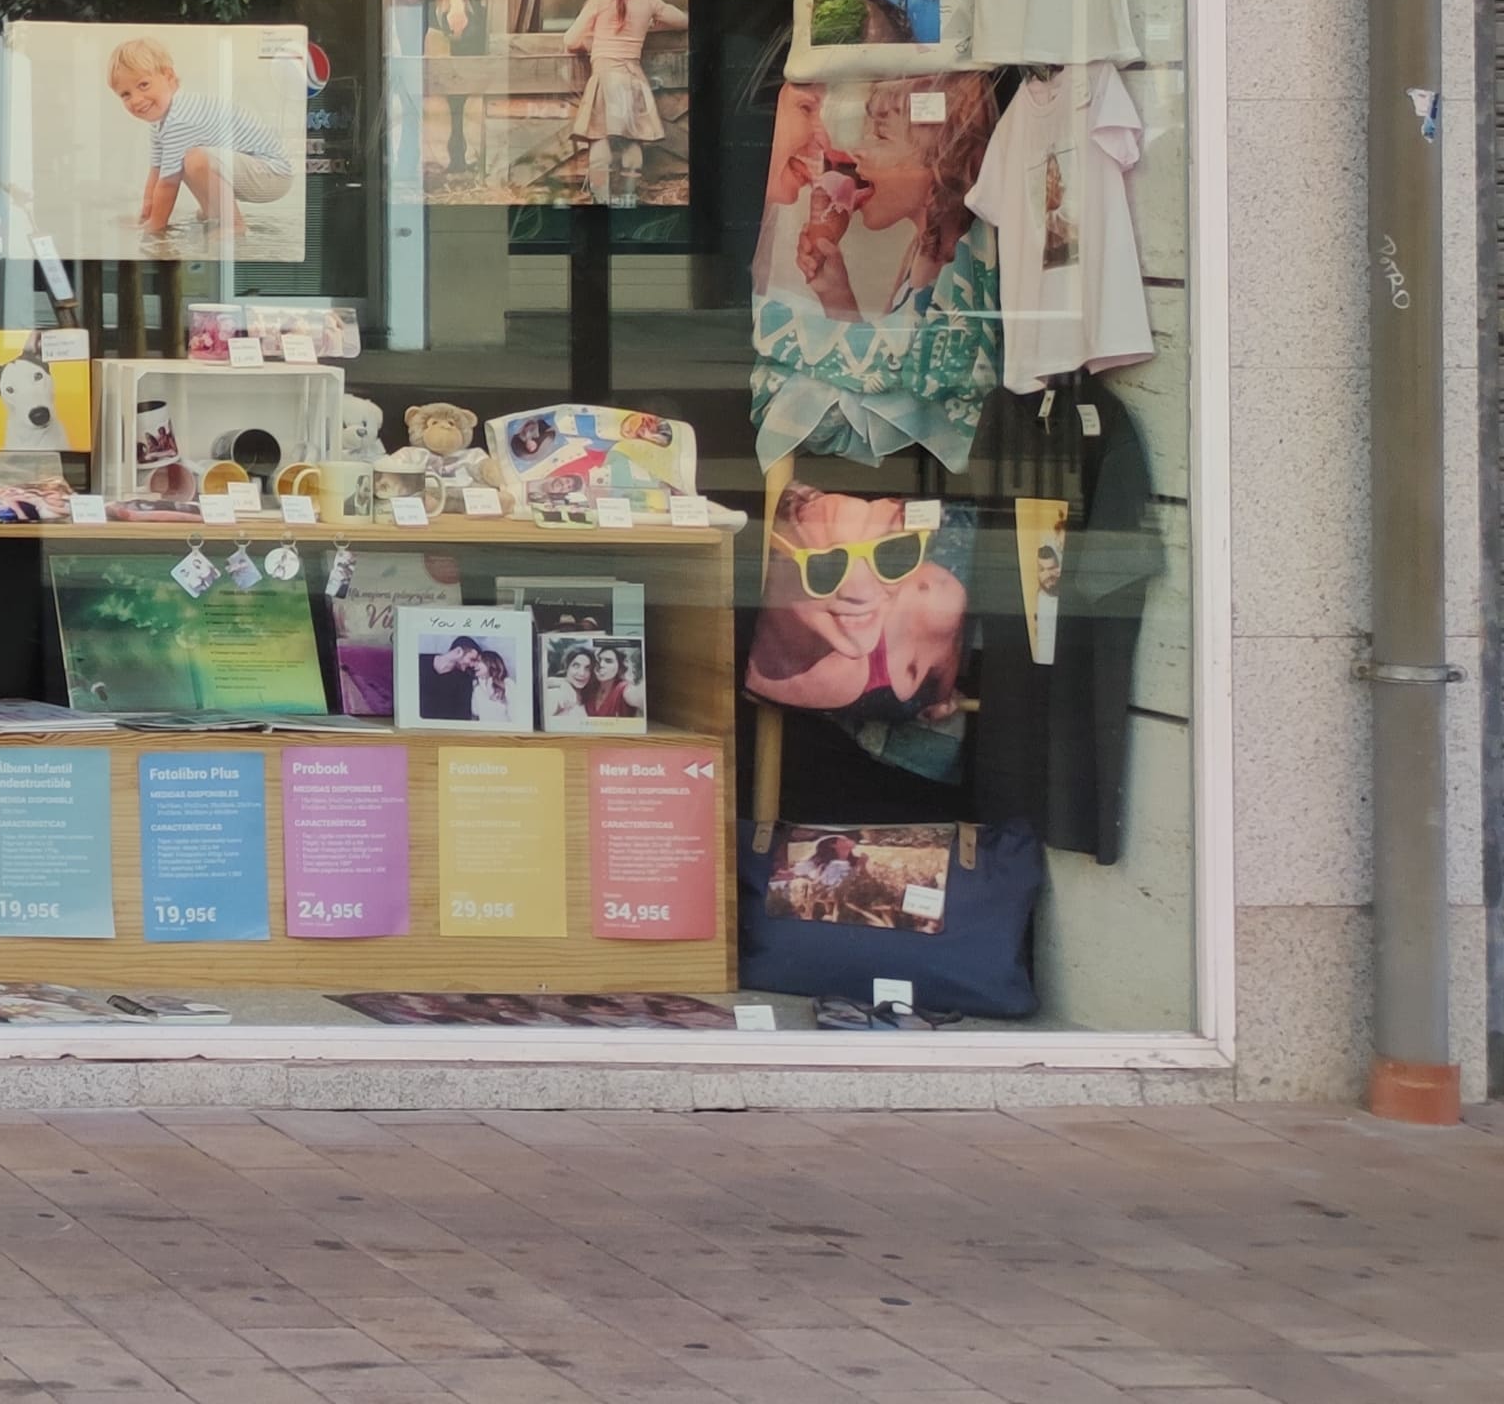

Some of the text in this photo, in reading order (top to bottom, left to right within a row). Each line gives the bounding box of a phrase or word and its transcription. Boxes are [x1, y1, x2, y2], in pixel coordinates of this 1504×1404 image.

[428, 616, 502, 629] You & Me
[33, 762, 73, 774] Infantil
[149, 767, 240, 781] Fotolibro Plus
[292, 761, 348, 775] Probook
[448, 762, 508, 776] Fotolibro
[599, 763, 666, 777] New Book
[154, 905, 217, 926] 19,95€
[298, 900, 364, 922] 24,95€
[450, 899, 515, 920] 29,95€
[603, 901, 671, 923] 34,95€
